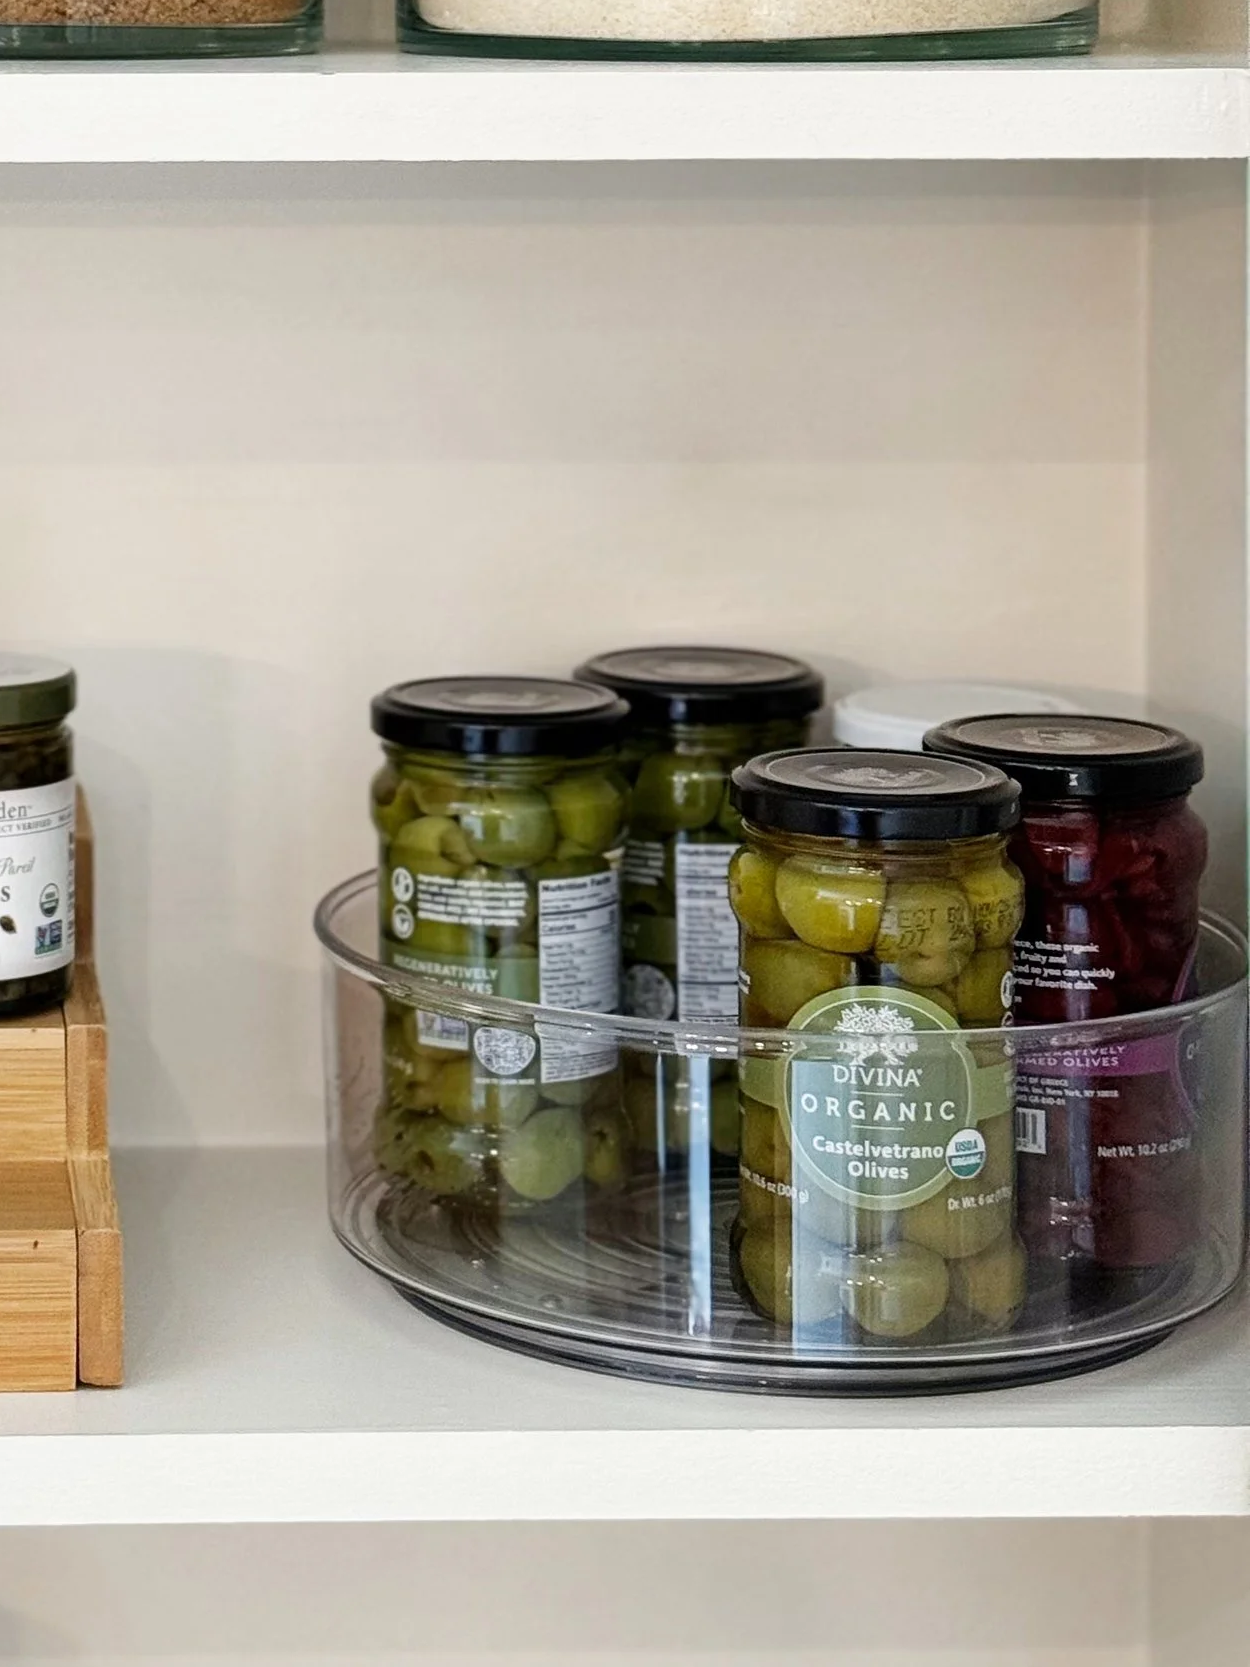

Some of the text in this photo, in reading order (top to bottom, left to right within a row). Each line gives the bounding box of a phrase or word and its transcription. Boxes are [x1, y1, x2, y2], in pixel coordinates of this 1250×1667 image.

[1063, 942, 1100, 955] organic
[1020, 950, 1068, 964] fruity and
[1080, 967, 1115, 981] quickly
[1035, 977, 1073, 990] favorite
[1062, 1055, 1120, 1068] OLIVES
[833, 1064, 919, 1088] DIVINA
[800, 1093, 956, 1122] ORGANIC
[812, 1135, 945, 1159] Castelvetrano
[1097, 1144, 1117, 1158] Net
[847, 1160, 910, 1181] Olives
